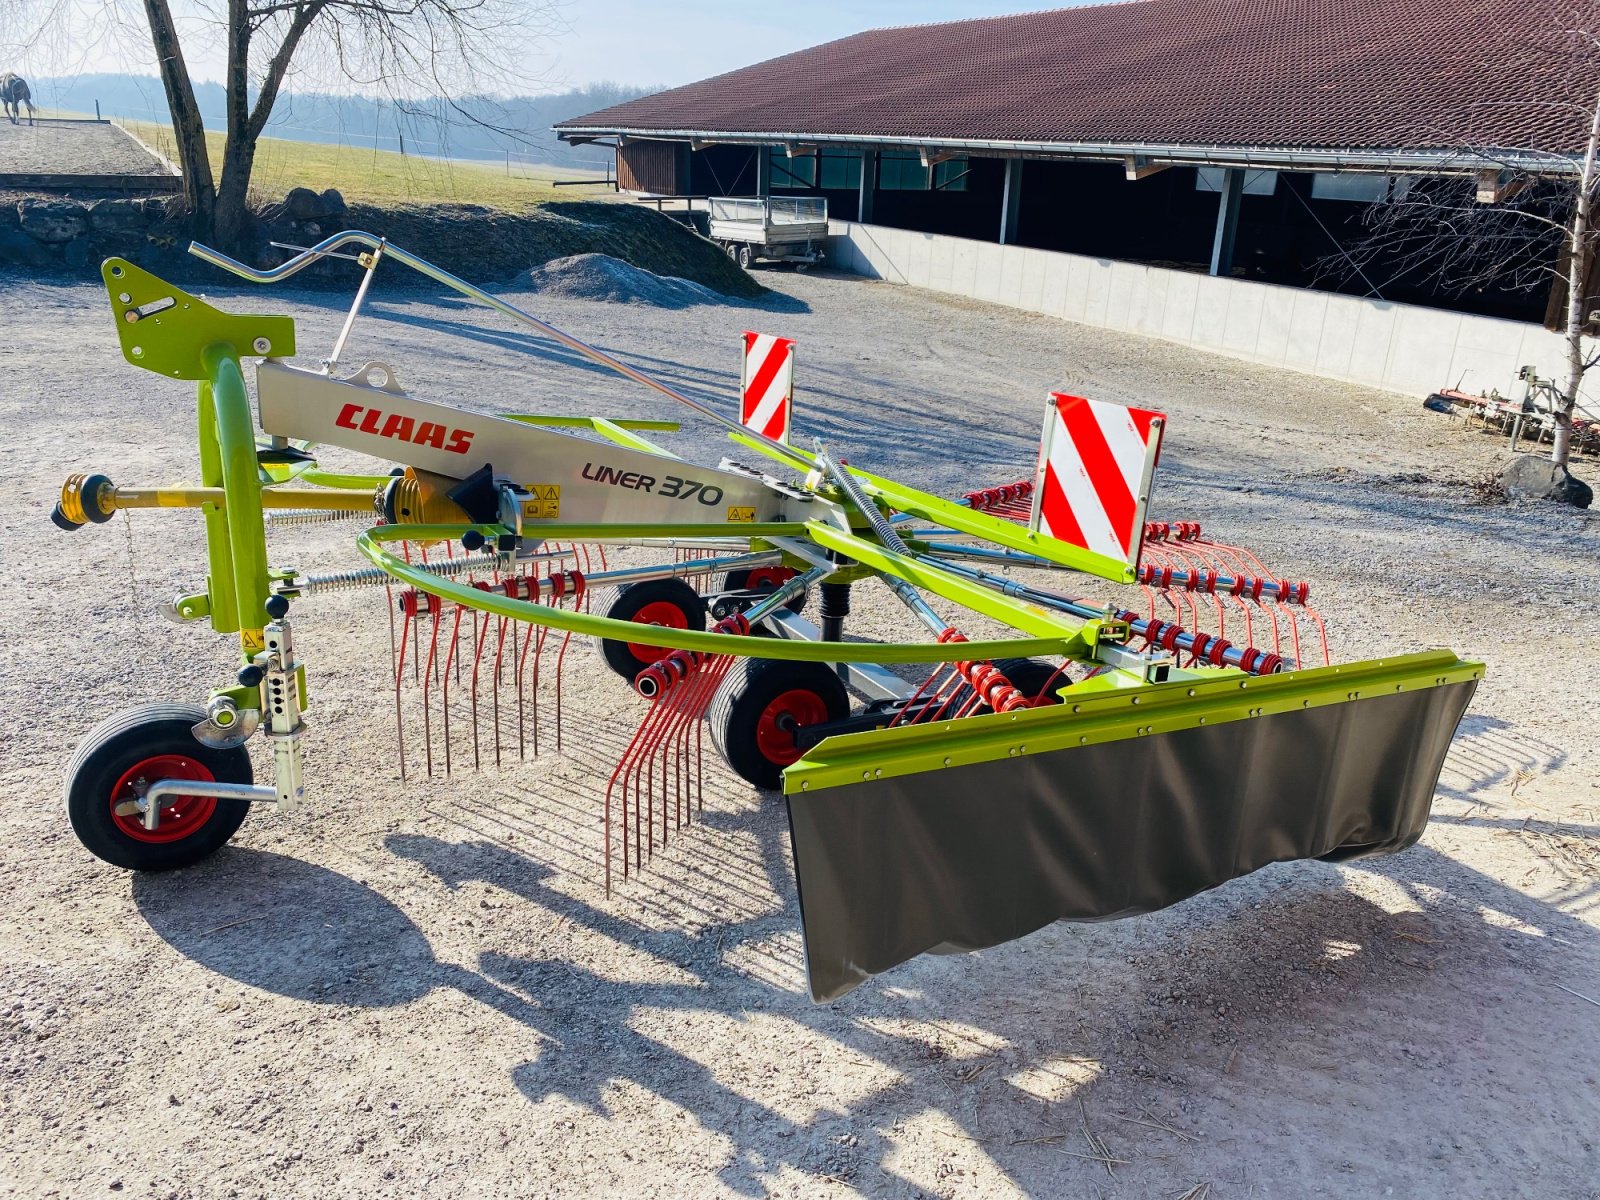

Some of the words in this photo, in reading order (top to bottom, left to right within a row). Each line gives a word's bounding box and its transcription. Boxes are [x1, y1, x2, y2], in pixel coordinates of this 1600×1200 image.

[335, 403, 475, 455] CLAAS
[581, 462, 656, 492] LINER
[658, 475, 724, 506] 370
